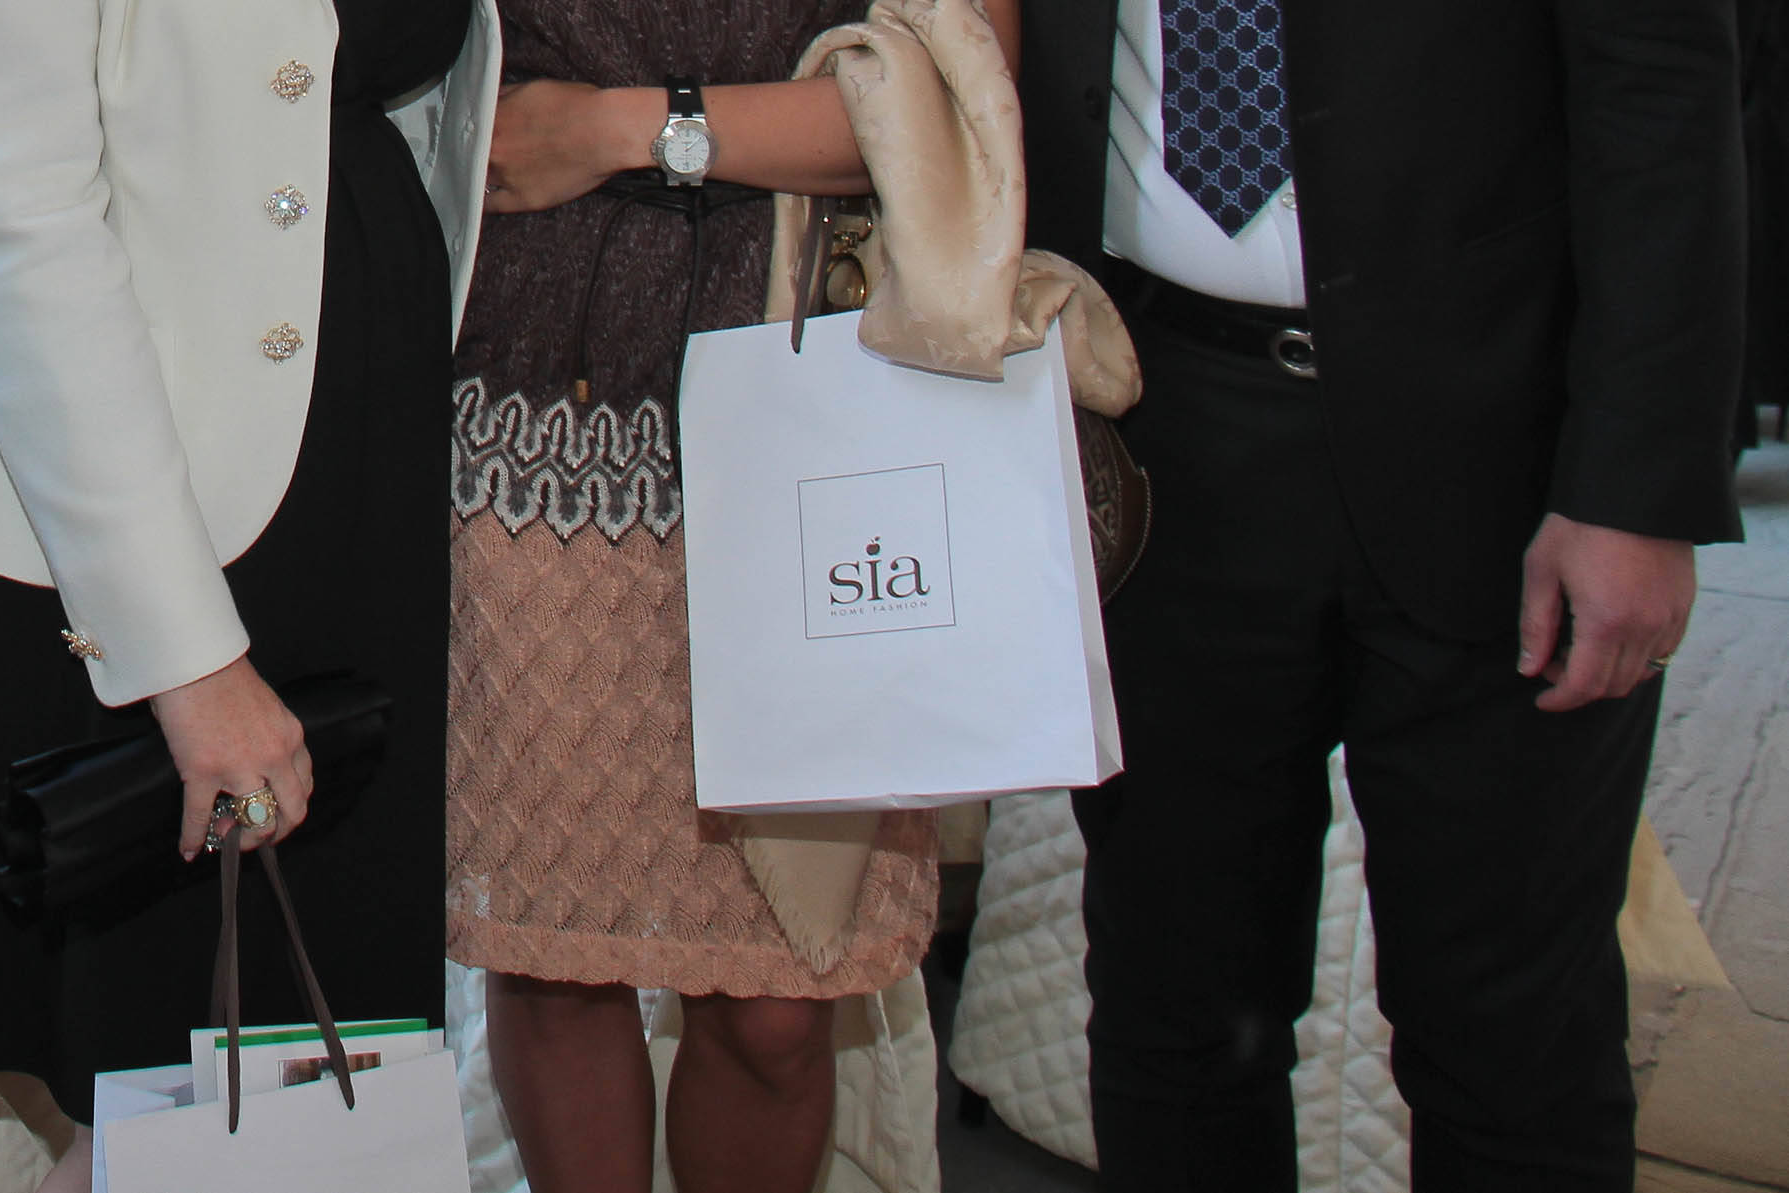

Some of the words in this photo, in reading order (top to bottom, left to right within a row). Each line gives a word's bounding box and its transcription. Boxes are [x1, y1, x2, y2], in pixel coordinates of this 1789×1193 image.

[828, 536, 931, 606] sia
[830, 607, 865, 617] HOME
[873, 600, 928, 613] FASHION
